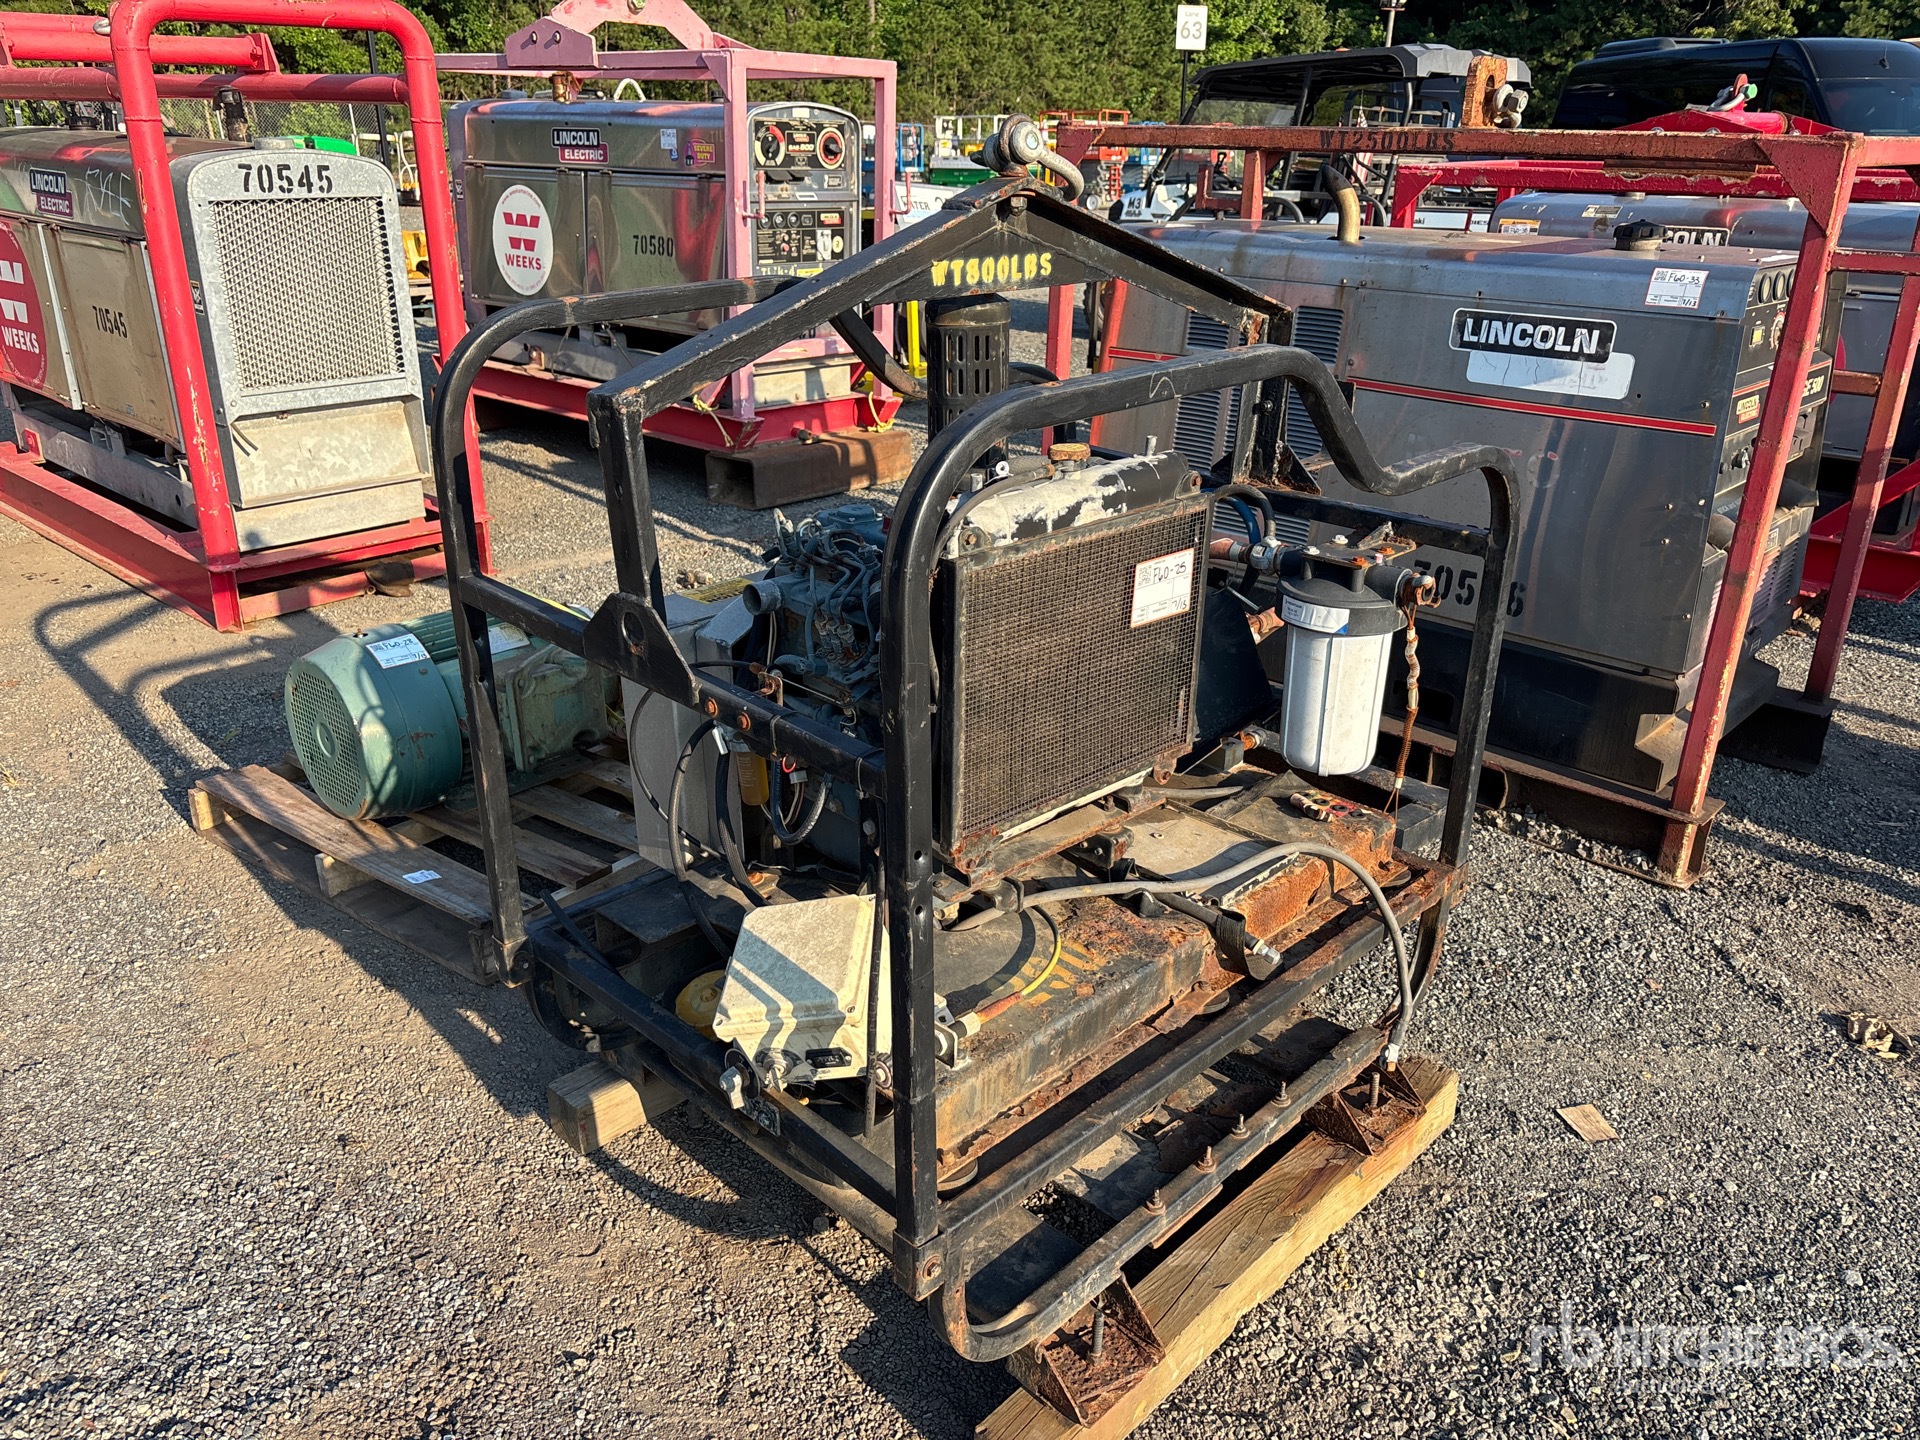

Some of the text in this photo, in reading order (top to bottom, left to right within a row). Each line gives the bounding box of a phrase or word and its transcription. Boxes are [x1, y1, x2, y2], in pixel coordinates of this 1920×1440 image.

[1181, 20, 1202, 39] 63
[554, 130, 598, 146] LINCOLN
[564, 149, 604, 160] ELECTRIC
[30, 172, 65, 195] LINCOLN
[237, 163, 333, 194] 70545
[40, 196, 70, 214] ELECTRIC
[632, 234, 674, 258] 70580
[504, 252, 542, 270] WEEKS
[931, 252, 1052, 286] WT800LBS
[92, 305, 128, 338] 70545
[1, 325, 40, 354] WEEKS
[1463, 318, 1600, 355] LINCOLN
[1153, 561, 1187, 583] F60-25
